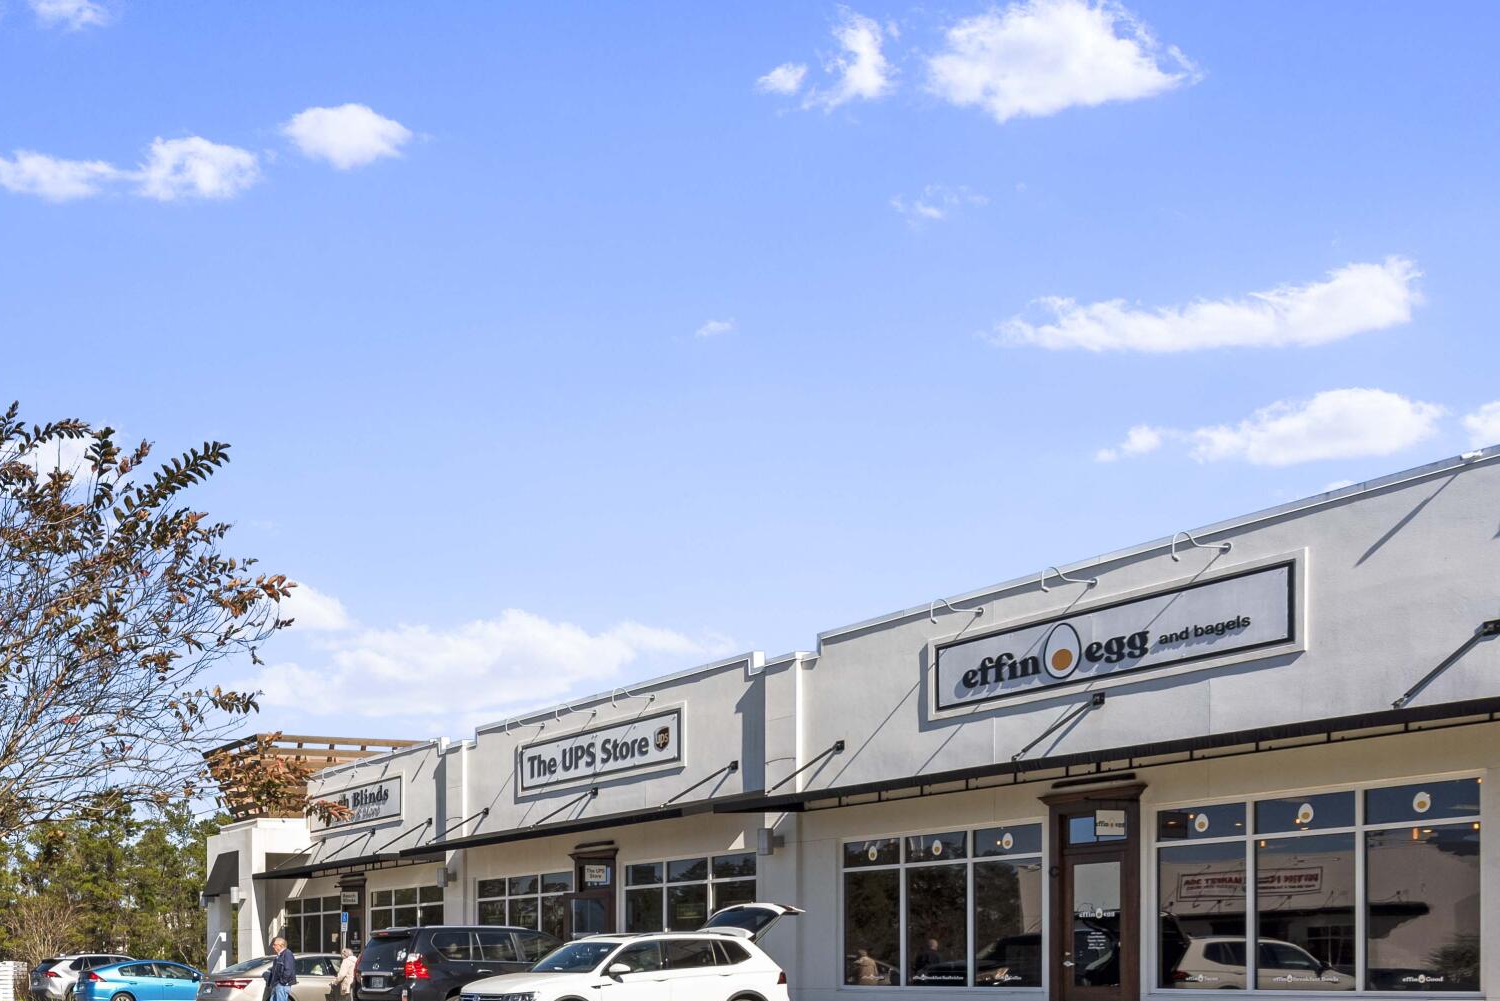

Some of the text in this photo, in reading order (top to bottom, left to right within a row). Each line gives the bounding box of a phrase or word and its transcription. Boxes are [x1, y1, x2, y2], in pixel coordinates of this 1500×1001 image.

[962, 615, 1251, 689] effin egg and bagels
[655, 732, 670, 748] ups
[527, 736, 650, 779] The UPS Store
[352, 785, 389, 807] Blinds
